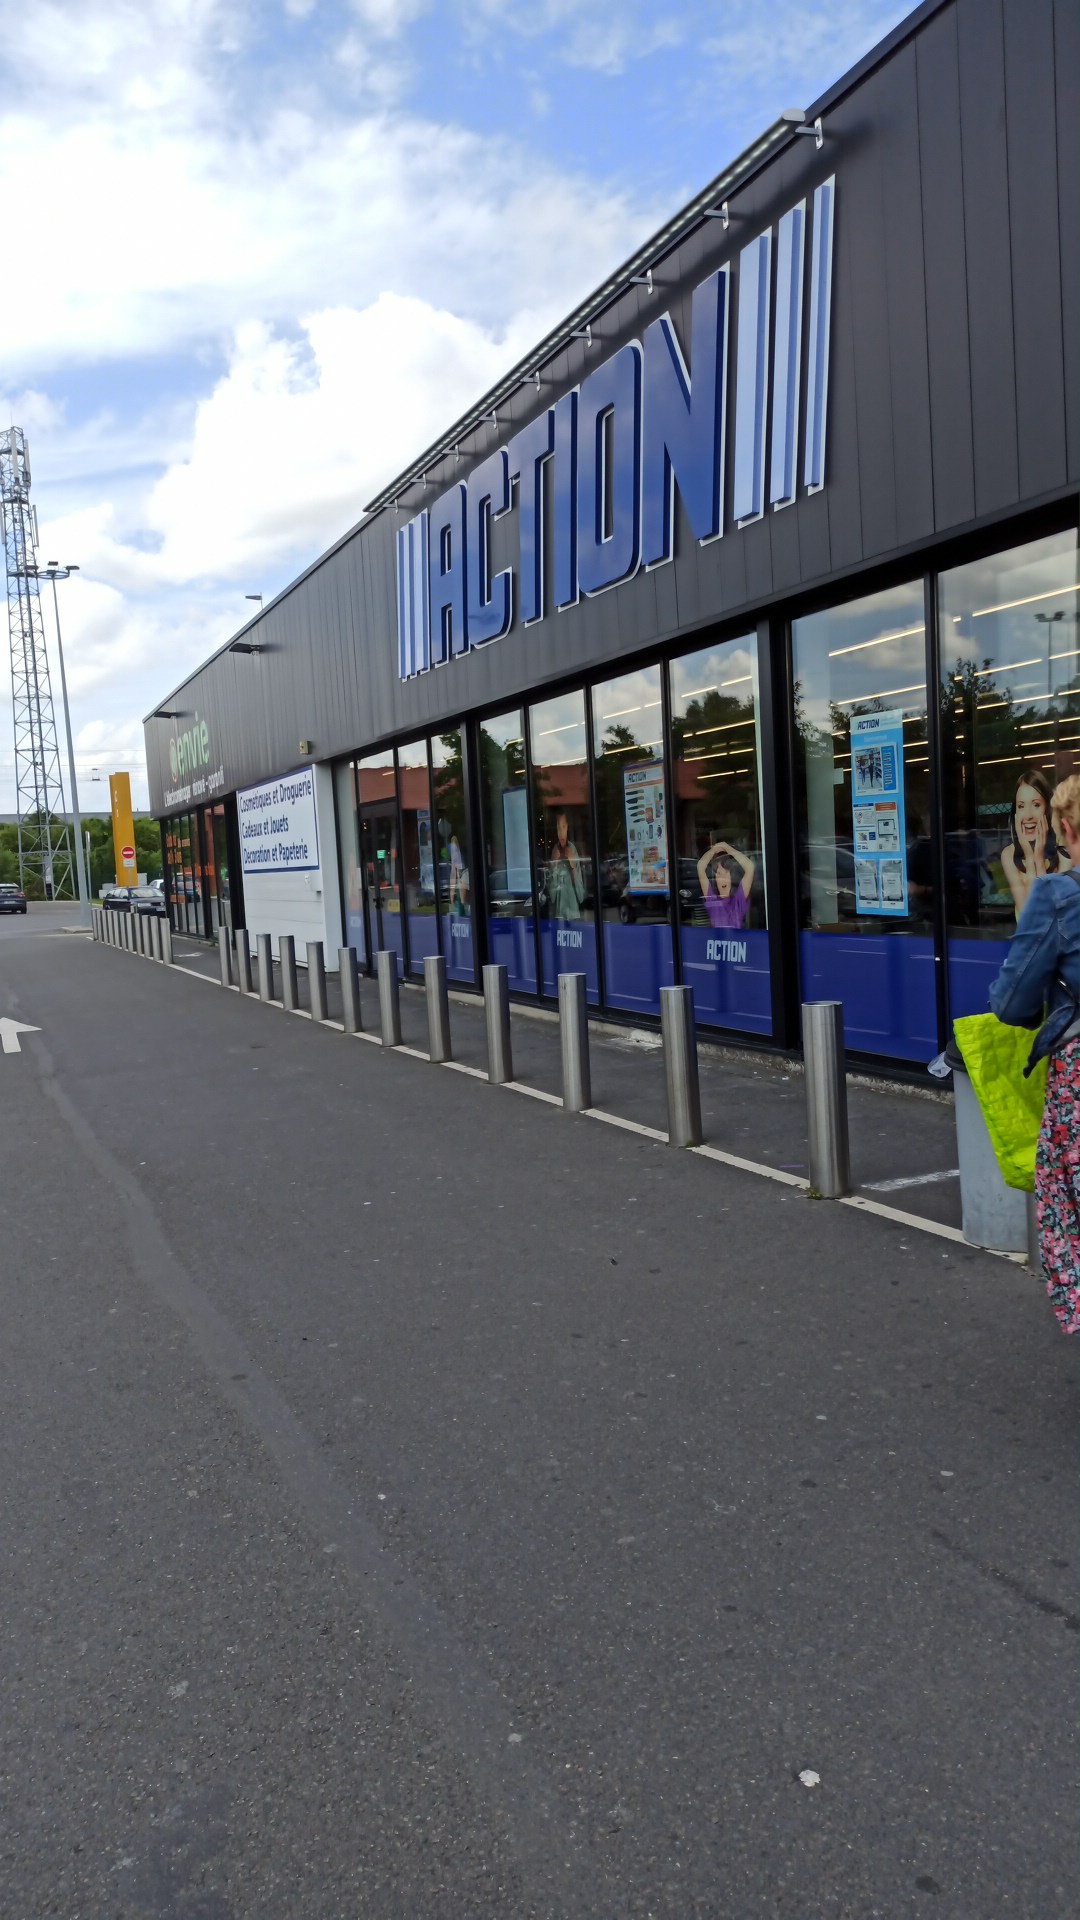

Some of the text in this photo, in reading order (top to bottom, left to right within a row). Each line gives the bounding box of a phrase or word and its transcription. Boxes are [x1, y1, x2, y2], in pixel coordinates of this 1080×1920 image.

[430, 261, 730, 669] ACTION
[857, 719, 880, 730] ACTION
[177, 711, 209, 776] envie
[627, 771, 647, 782] ACTION
[240, 774, 311, 813] Cosmétiques et Droguerie
[242, 814, 289, 839] Cadeaux et Jouets
[272, 844, 278, 862] et
[279, 838, 308, 866] Papeterie
[451, 923, 470, 937] ACTION
[556, 930, 582, 948] ACTION
[706, 939, 747, 963] ACTION
